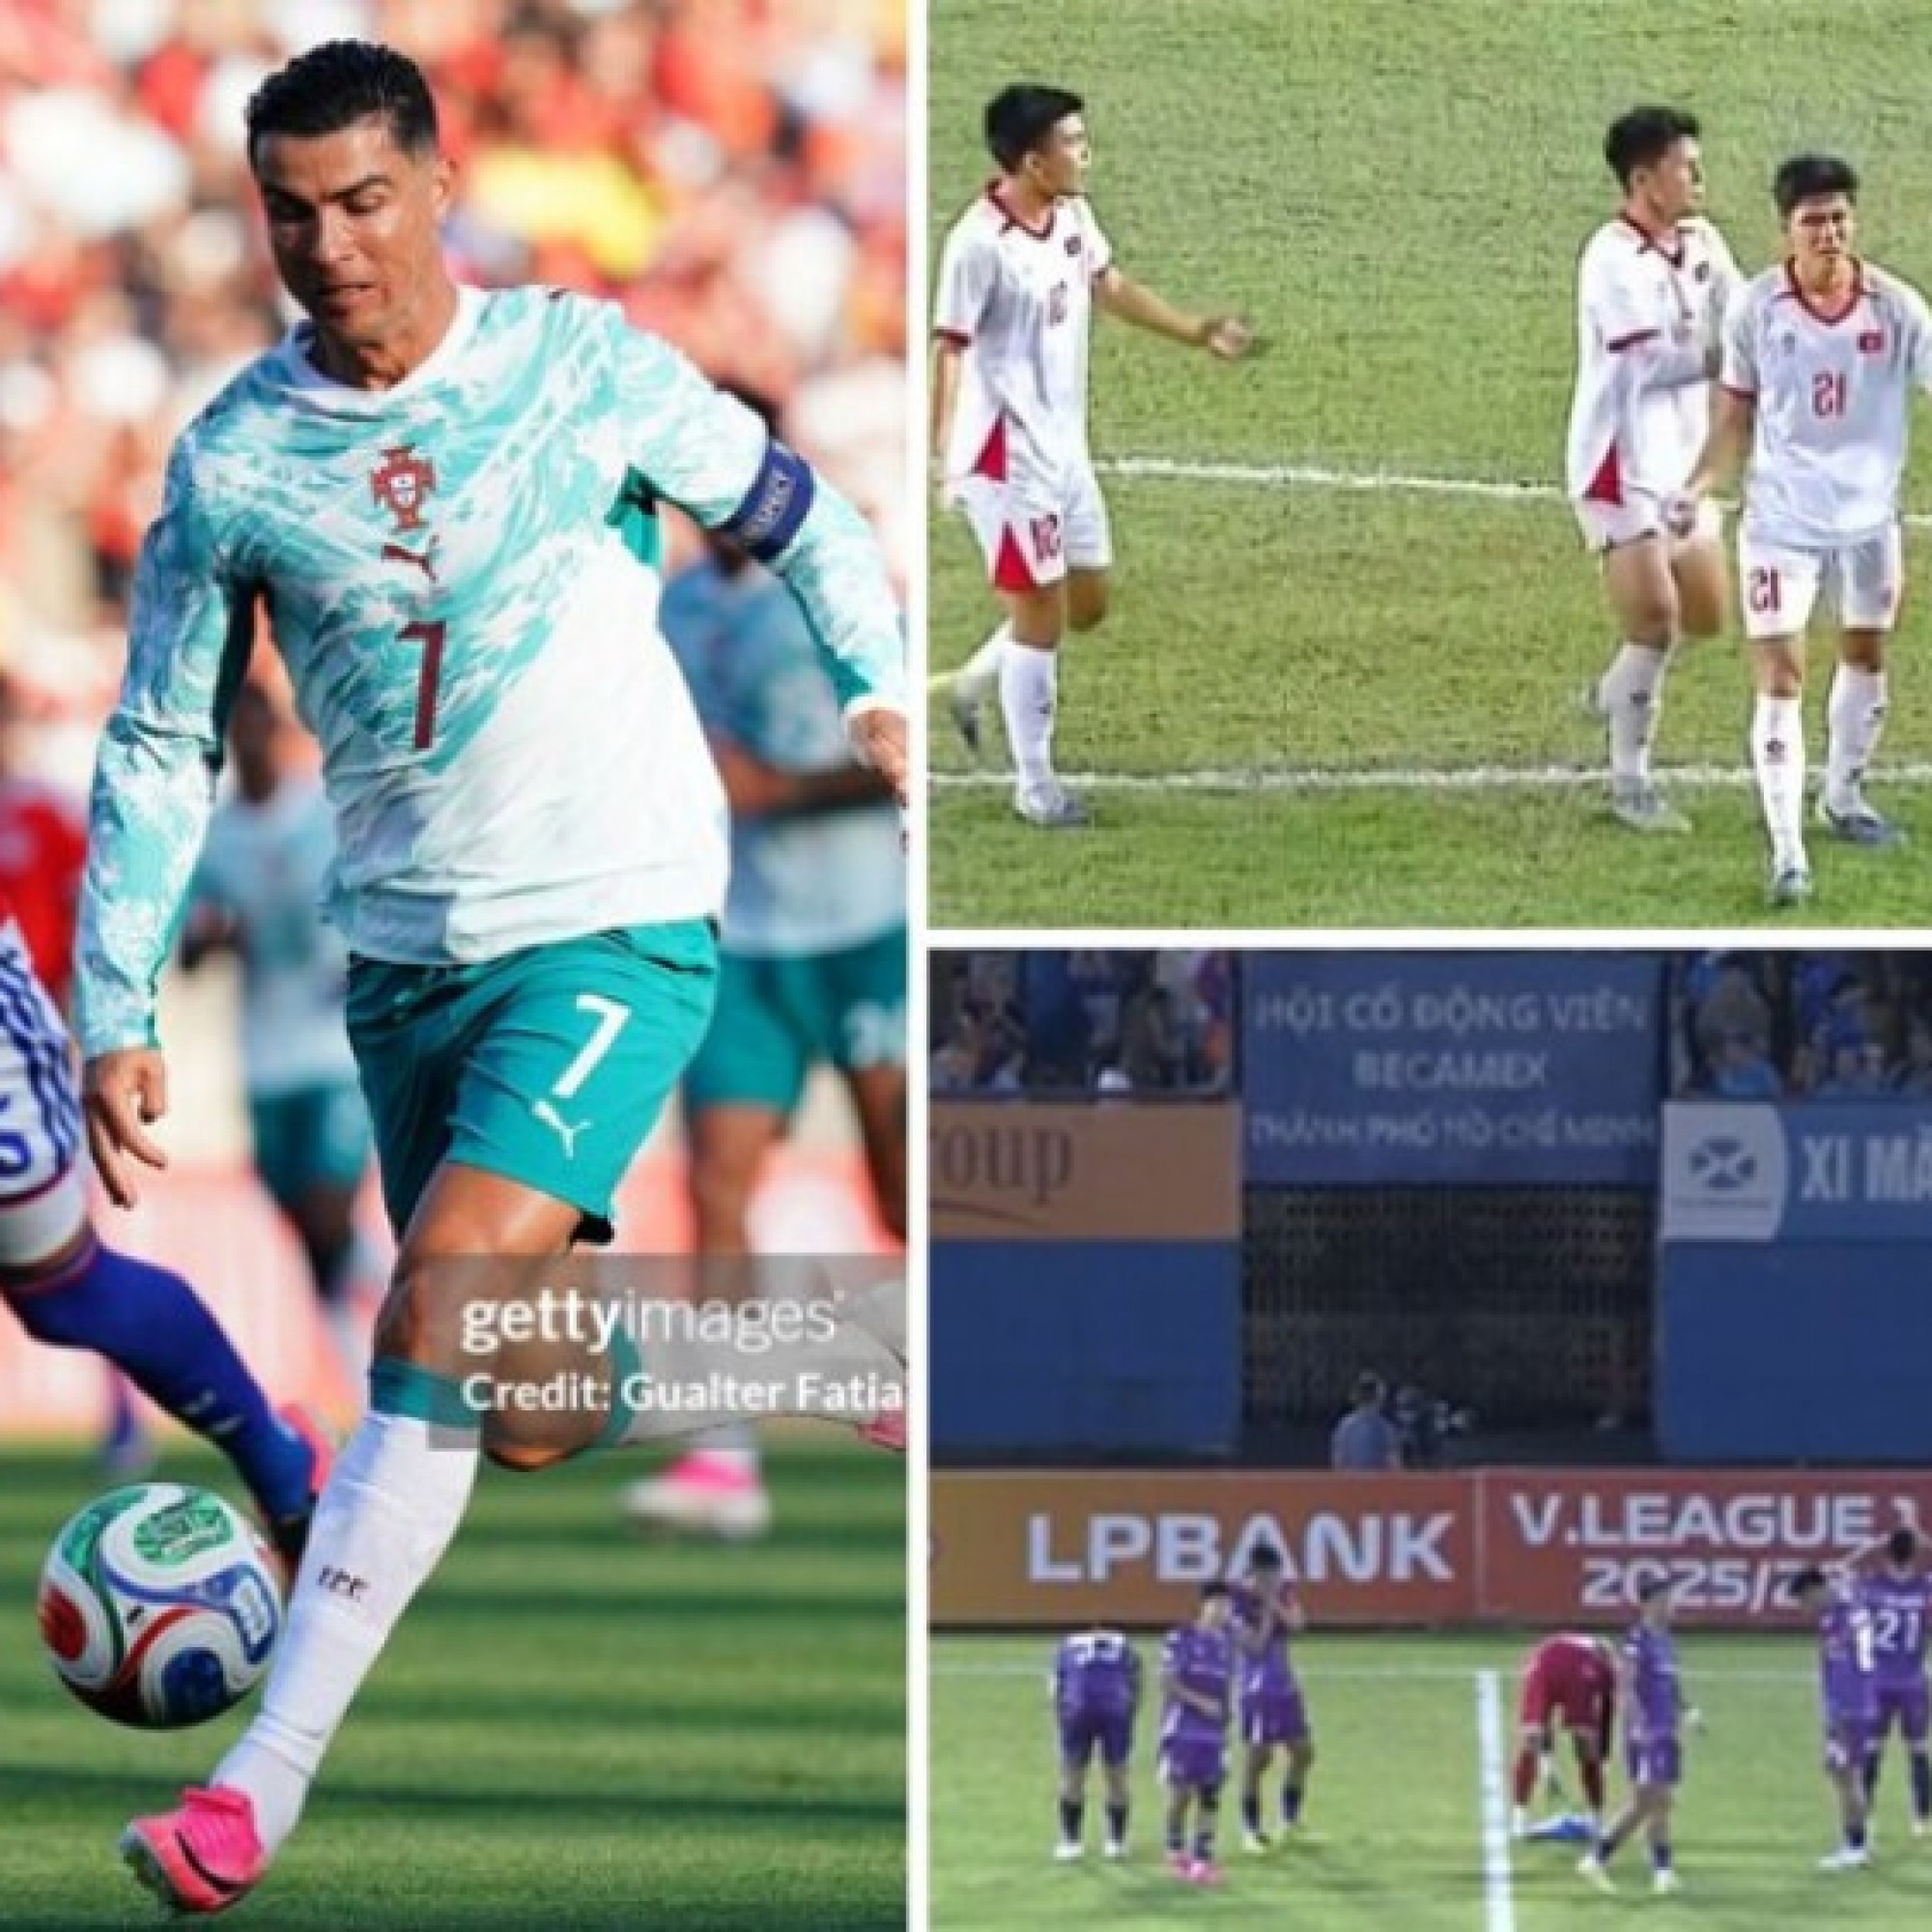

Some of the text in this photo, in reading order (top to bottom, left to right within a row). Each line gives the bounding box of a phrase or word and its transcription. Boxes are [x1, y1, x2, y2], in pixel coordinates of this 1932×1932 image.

[395, 619, 445, 750] 7
[552, 993, 630, 1099] 7
[1353, 1050, 1547, 1090] BECAMEX
[1801, 1135, 1852, 1201] XI
[1027, 1513, 1456, 1582] LPBANK
[1510, 1493, 1875, 1547] V.LEAGUE
[1875, 1609, 1920, 1652] 21
